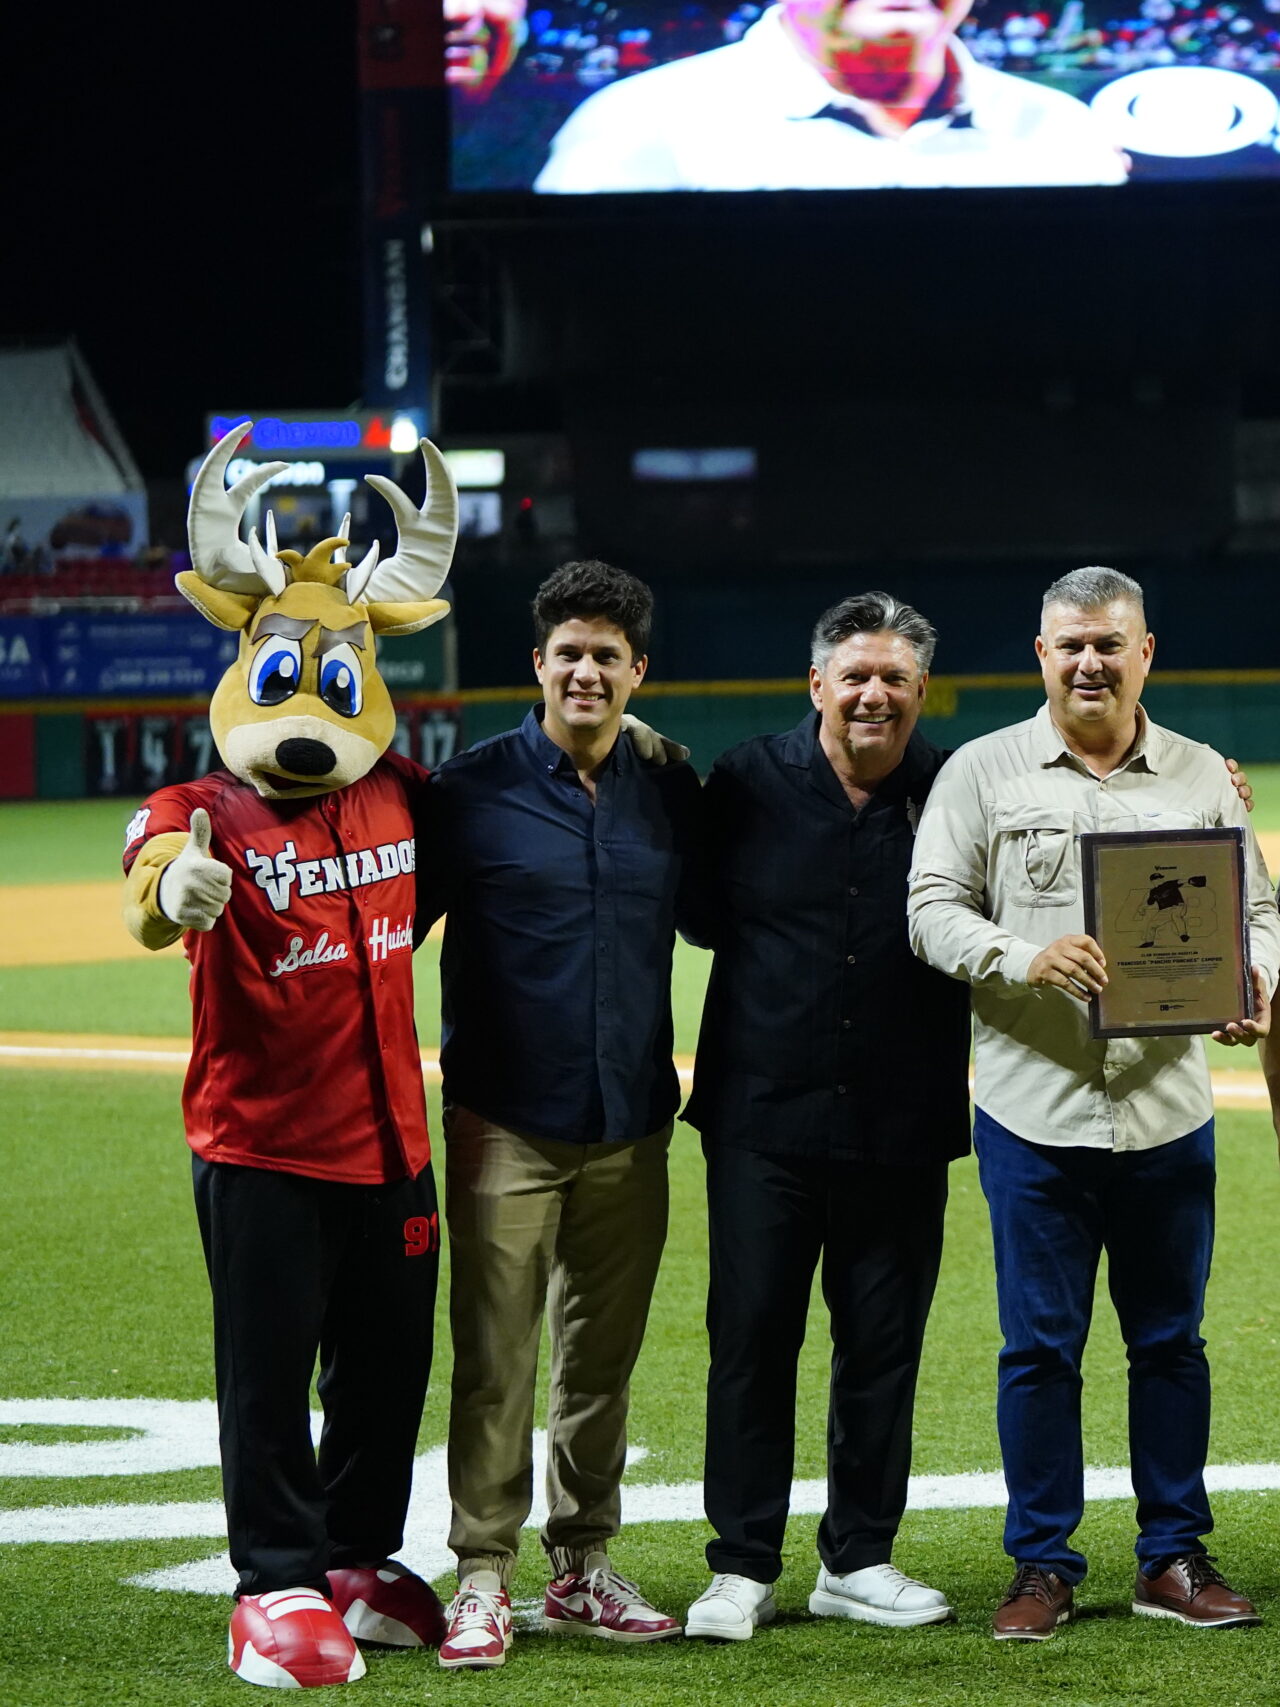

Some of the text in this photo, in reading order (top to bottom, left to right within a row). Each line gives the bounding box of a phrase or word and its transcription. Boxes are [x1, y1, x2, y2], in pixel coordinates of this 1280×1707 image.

[384, 238, 409, 390] CHANGAN
[253, 417, 361, 449] Chevron
[269, 932, 348, 977] Salsa
